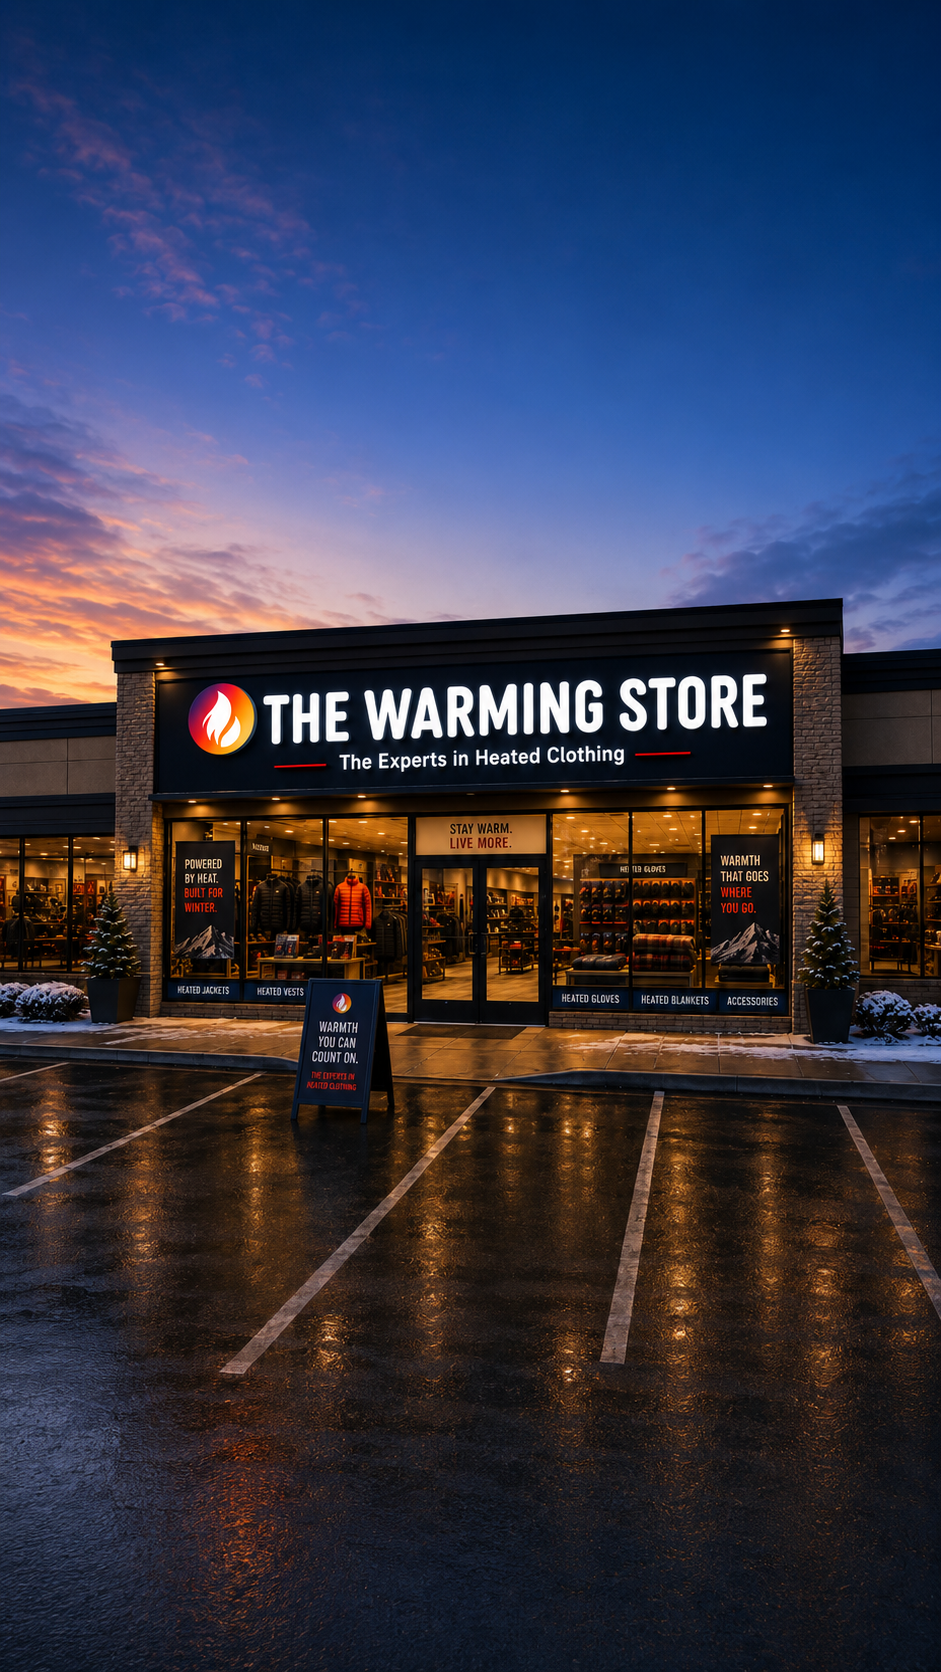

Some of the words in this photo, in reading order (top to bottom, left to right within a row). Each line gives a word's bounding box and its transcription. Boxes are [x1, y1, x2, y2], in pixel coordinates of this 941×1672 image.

[263, 691, 350, 745] THE
[364, 680, 603, 742] WARMING
[619, 674, 768, 732] STORE
[339, 753, 373, 771] The
[379, 750, 447, 773] Experts
[453, 749, 470, 766] in
[476, 747, 541, 766] Heated
[547, 745, 625, 765] Clothing
[450, 823, 474, 833] STAY
[478, 823, 512, 833] WARM.
[450, 837, 473, 848] LIVE
[478, 837, 512, 847] MORE.
[184, 858, 222, 870] POWERED
[720, 855, 761, 867] WARMTH
[184, 874, 195, 884] BY
[198, 873, 218, 884] HEAT.
[721, 871, 743, 882] THAT
[746, 870, 769, 882] GOES
[184, 888, 205, 898] BUILT
[208, 888, 223, 898] FOR
[720, 887, 752, 898] WHERE
[184, 902, 217, 912] WINTER.
[721, 902, 739, 914] YOU
[742, 902, 756, 913] GO.
[177, 986, 200, 995] HEATED
[202, 986, 230, 995] JACKETS
[257, 987, 282, 996] HEATED
[283, 988, 304, 997] VESTS
[561, 993, 589, 1003] HEATED
[591, 994, 620, 1004] GLOVES
[641, 995, 669, 1005] HEATED
[671, 995, 709, 1006] BLANKETS
[727, 996, 778, 1006] ACCESSORIES
[319, 1021, 358, 1033] WARMTH
[318, 1036, 335, 1048] YOU
[338, 1037, 356, 1049] CAN
[312, 1051, 342, 1063] COUNT
[344, 1052, 358, 1064] ON.
